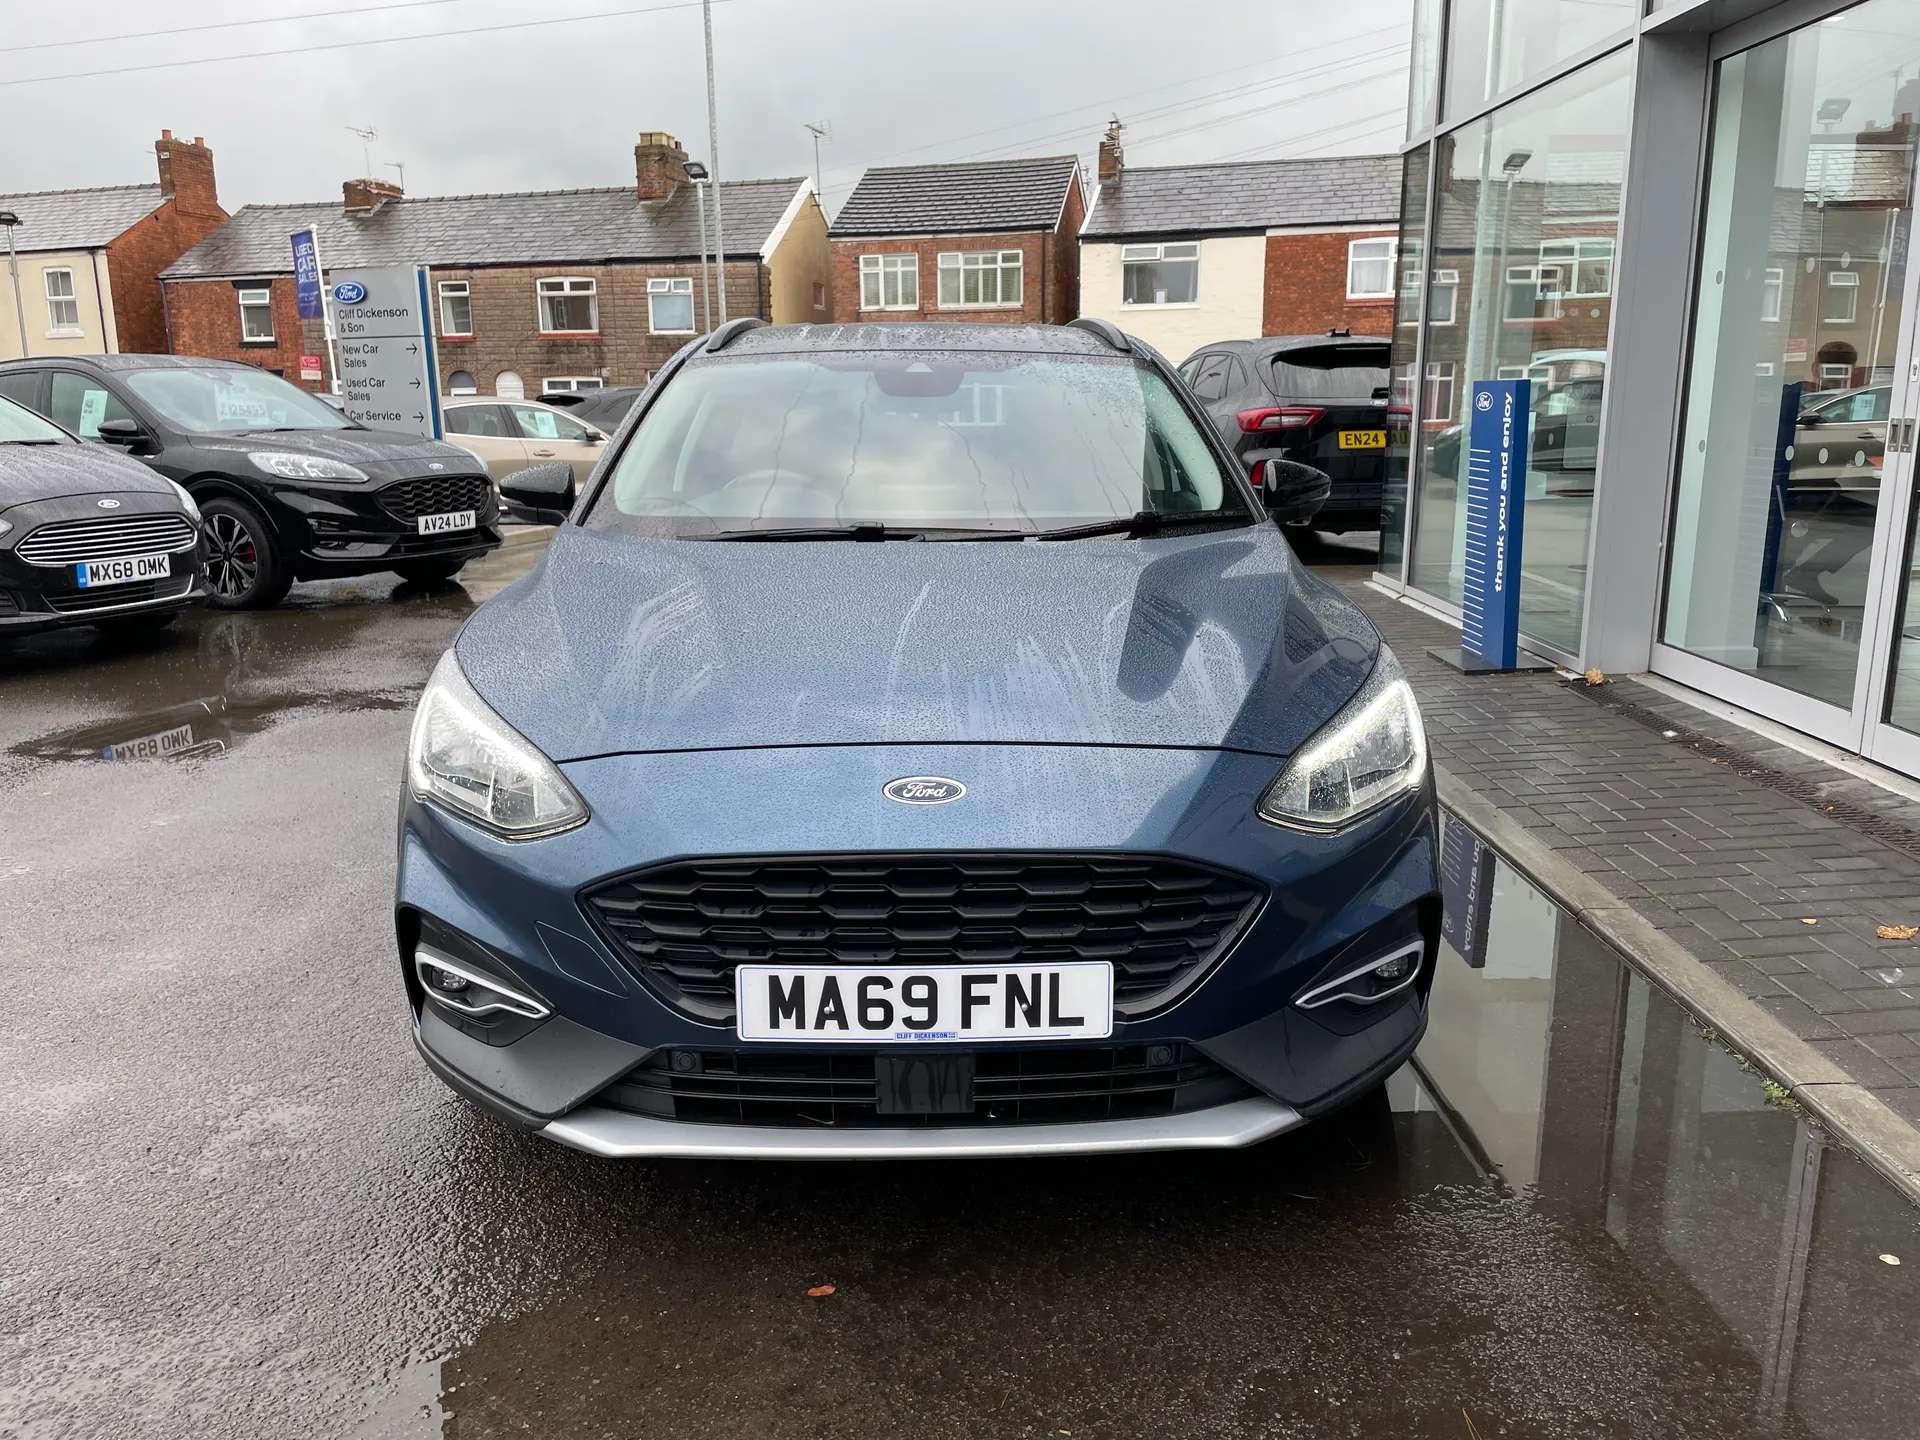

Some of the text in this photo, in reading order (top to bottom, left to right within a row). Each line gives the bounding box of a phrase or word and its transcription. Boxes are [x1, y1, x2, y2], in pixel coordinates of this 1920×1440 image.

[295, 243, 313, 257] USED
[297, 255, 316, 273] CAR
[339, 308, 409, 320] Cliff Dickenson
[341, 322, 365, 333] & Son
[342, 344, 379, 354] New Car
[344, 358, 367, 368] Sales
[346, 377, 385, 388] Used Car
[347, 391, 371, 401] Sales
[350, 410, 402, 421] Car Service
[1345, 432, 1380, 446] EN24
[1494, 392, 1513, 592] thank you and enjoy
[424, 513, 472, 532] AV24 LDY
[89, 556, 168, 583] MX68 OMK
[902, 782, 948, 798] Ford
[768, 972, 1085, 1031] MA69 FNL
